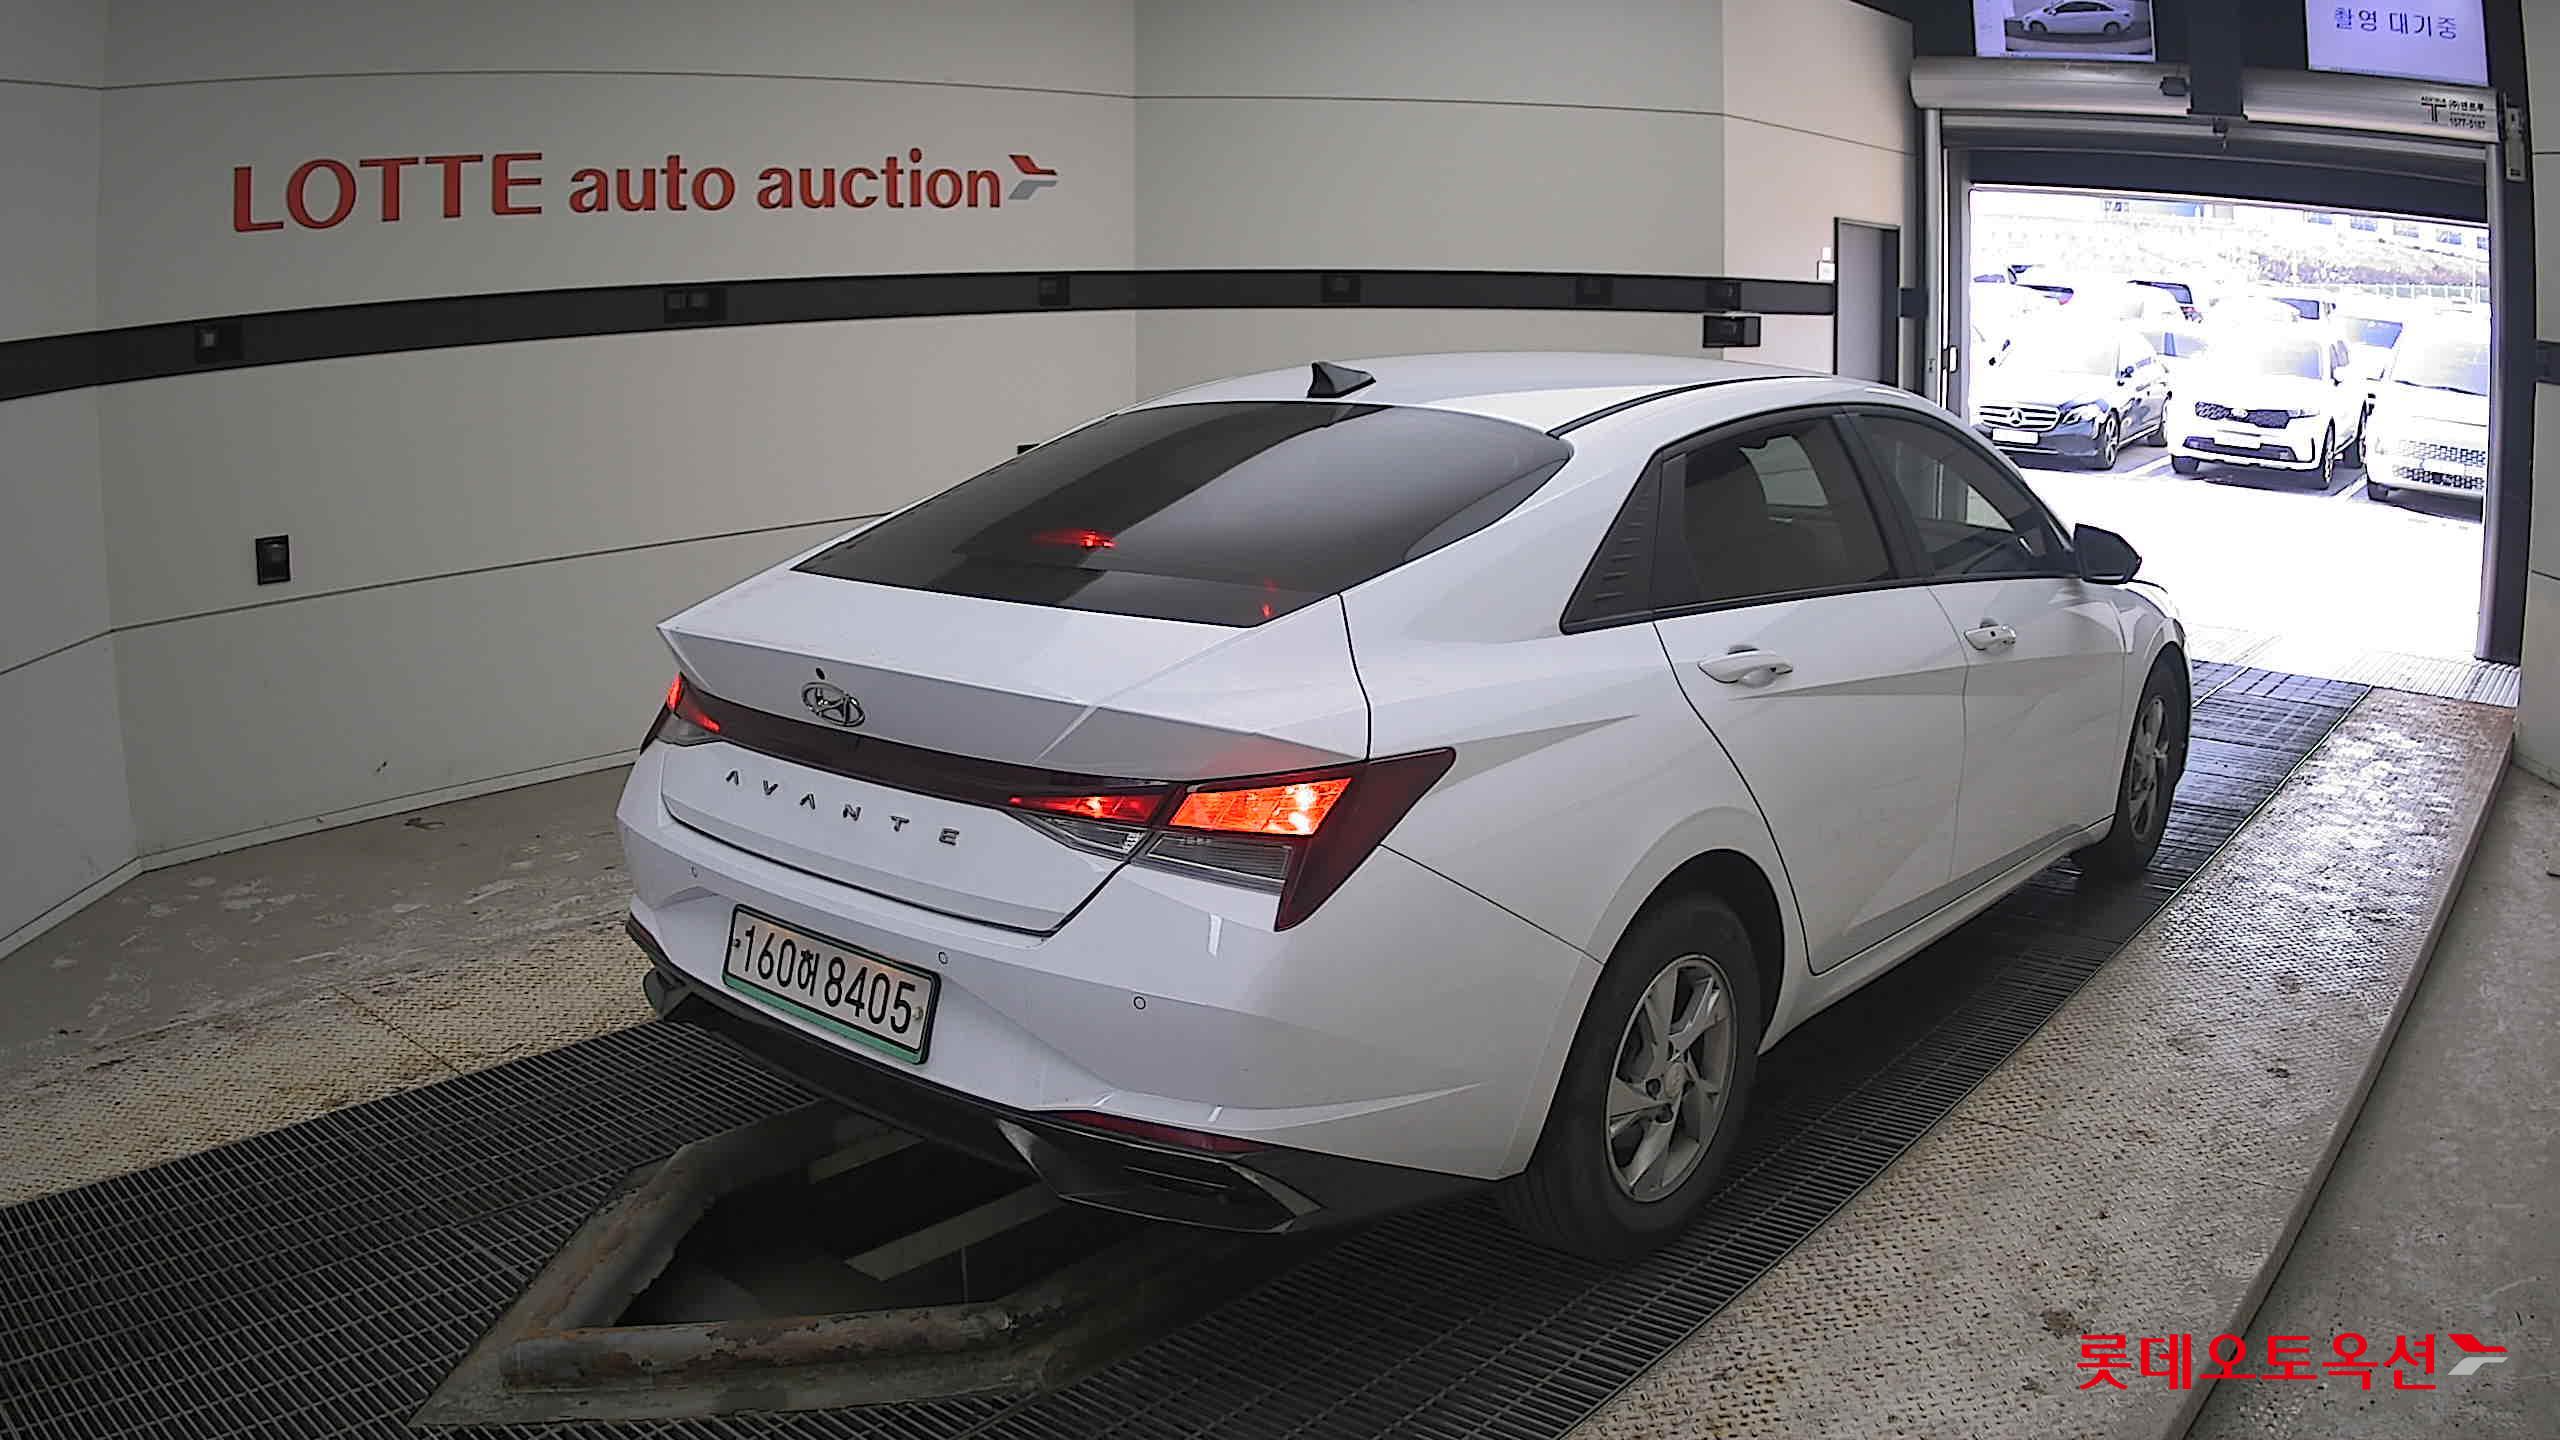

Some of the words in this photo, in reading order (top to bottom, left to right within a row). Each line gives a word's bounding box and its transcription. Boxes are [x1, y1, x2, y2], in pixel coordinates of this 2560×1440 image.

[2335, 7, 2377, 32] 촬영
[2389, 12, 2457, 40] 대기중
[233, 152, 543, 233] LOTTE
[569, 155, 736, 213] auto
[757, 148, 1002, 211] auction
[725, 768, 960, 846] AVANTE
[744, 925, 915, 1034] 160허8405
